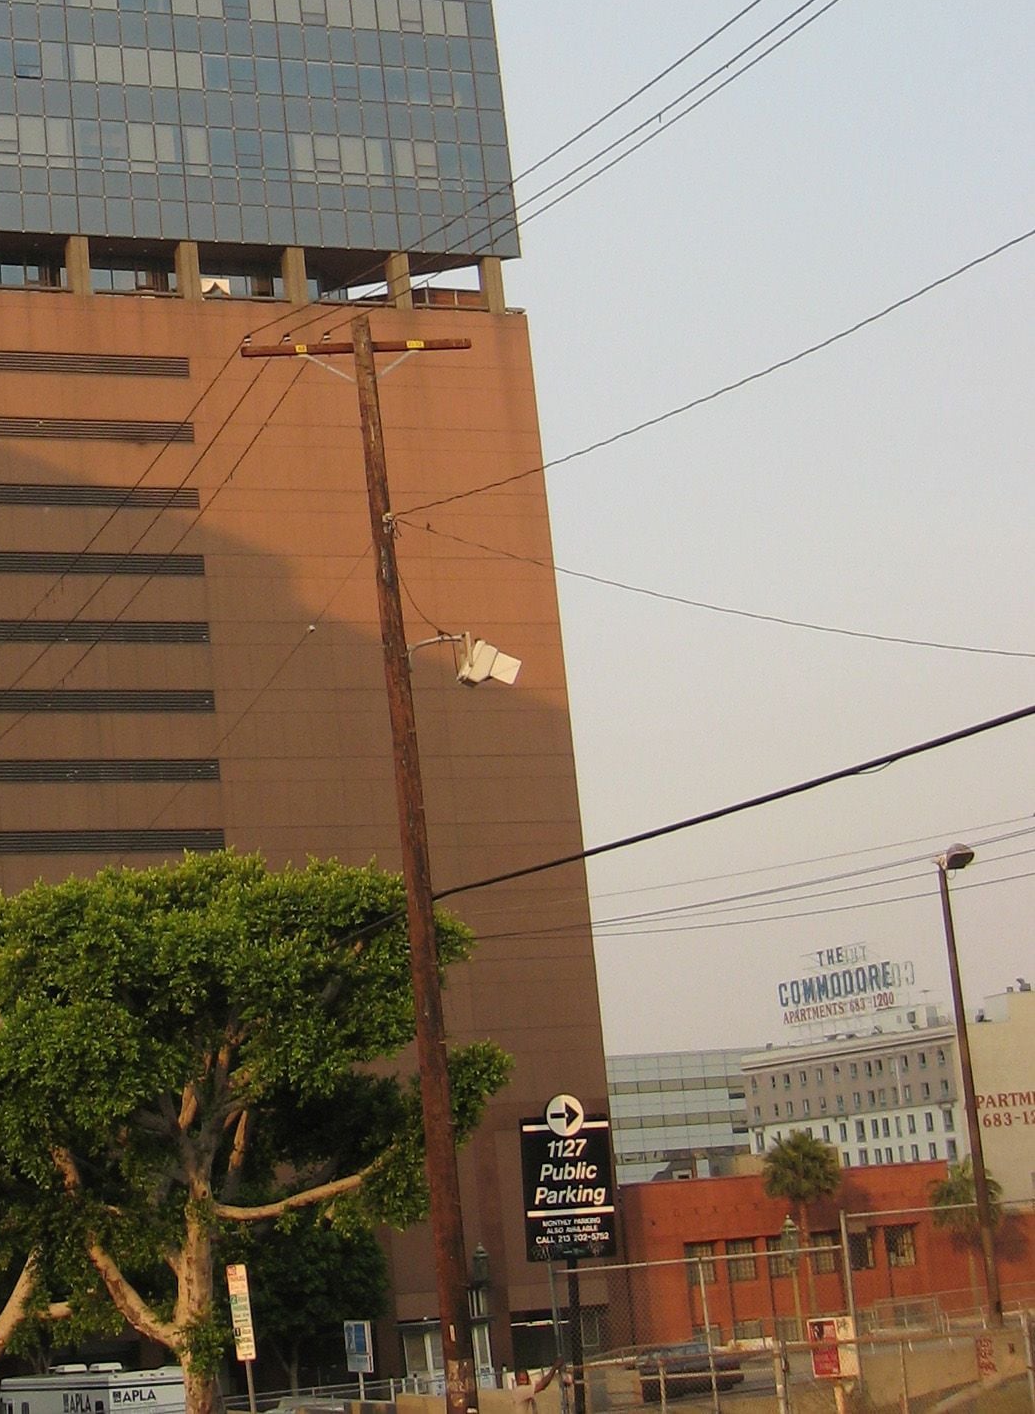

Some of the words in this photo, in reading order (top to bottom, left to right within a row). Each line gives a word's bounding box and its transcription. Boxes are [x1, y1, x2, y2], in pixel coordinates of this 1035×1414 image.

[817, 946, 843, 967] THE
[778, 961, 893, 1007] COMMODORE
[783, 1002, 845, 1025] APARTMENTS
[547, 1139, 587, 1158] 1127
[539, 1162, 598, 1181] Public
[534, 1185, 606, 1206] Parking
[542, 1219, 572, 1227] MONTHLY
[566, 1225, 598, 1233] AVAILABLE
[536, 1236, 555, 1244] CALL
[69, 1392, 92, 1413] APLA
[122, 1389, 157, 1402] APLA
